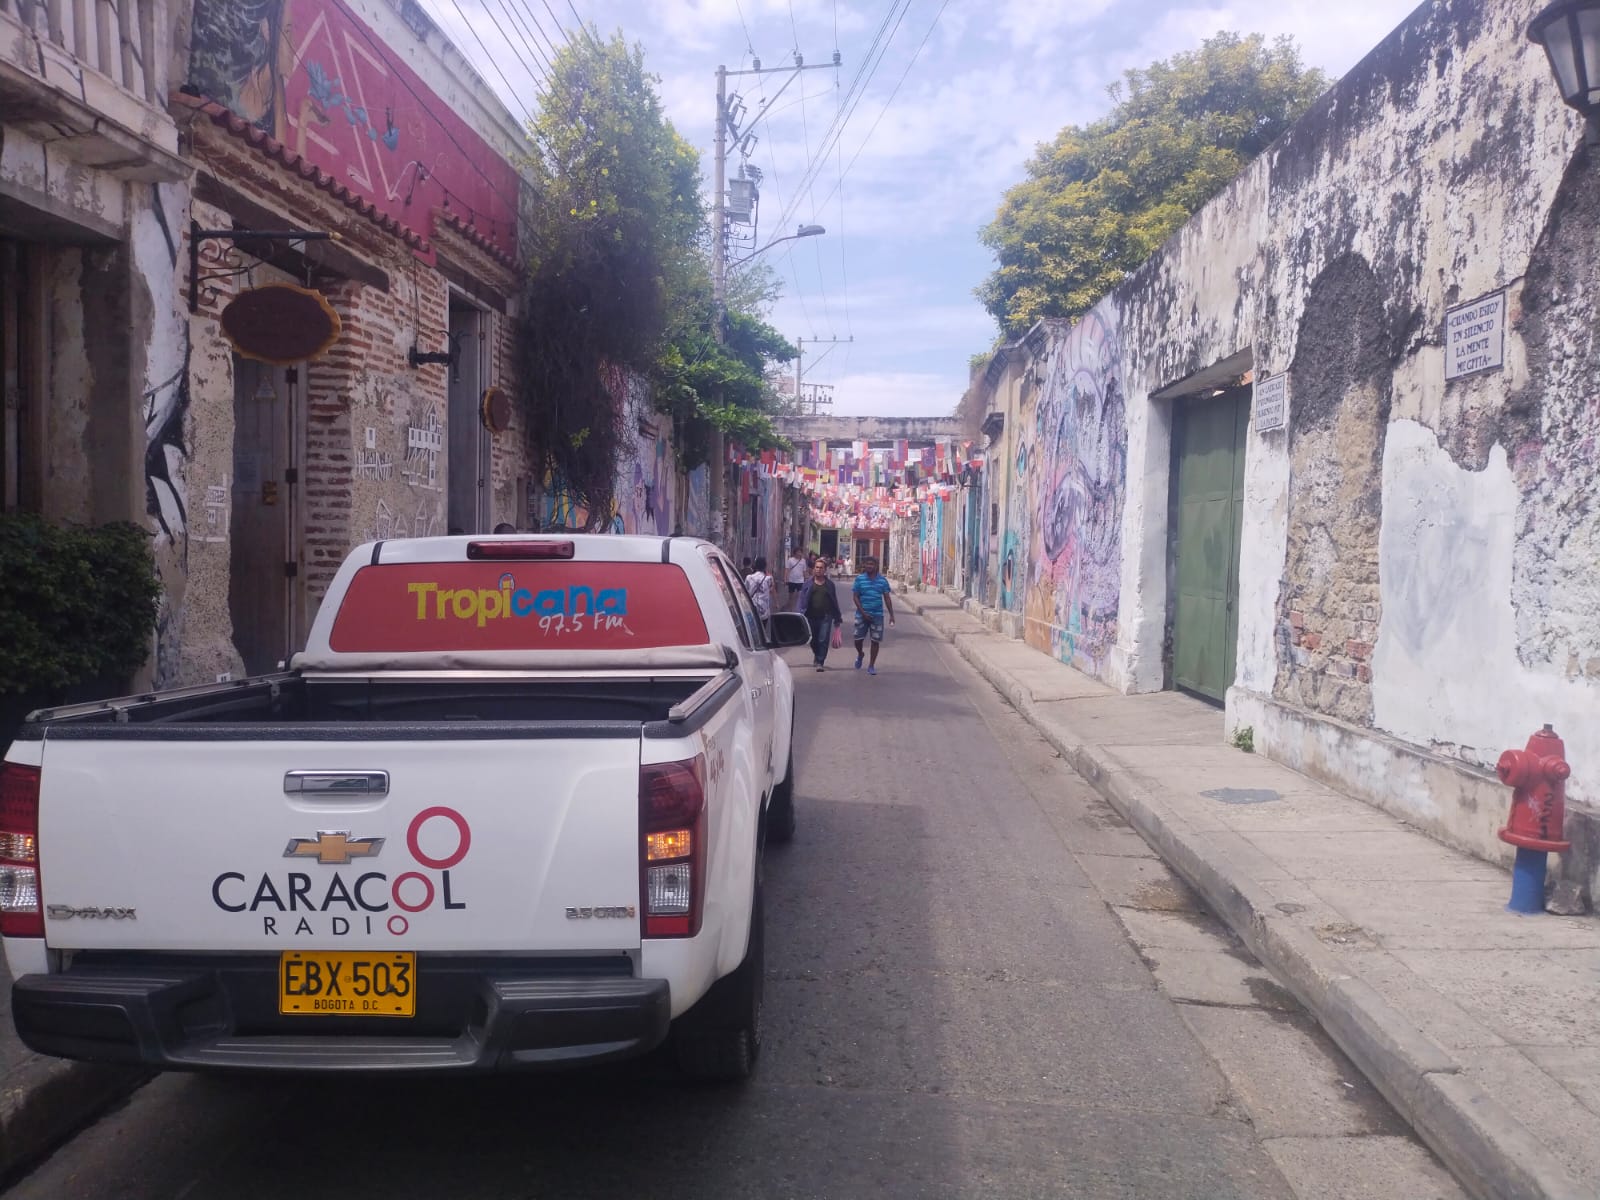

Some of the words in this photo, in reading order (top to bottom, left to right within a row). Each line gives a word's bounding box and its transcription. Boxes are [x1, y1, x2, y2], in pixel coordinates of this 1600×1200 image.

[1479, 301, 1499, 318] ESTOY
[1453, 330, 1462, 343] EN
[1464, 319, 1494, 339] SILENCIO
[1456, 346, 1466, 358] LA
[1467, 337, 1489, 355] MENTE
[1457, 360, 1466, 373] ME
[407, 579, 627, 627] Tropicana
[538, 612, 585, 636] 97.5
[212, 870, 466, 913] CARACOL
[264, 915, 408, 935] RADIO
[285, 961, 342, 996] EBX
[352, 962, 411, 998] 503
[314, 999, 355, 1010] BOGOTA
